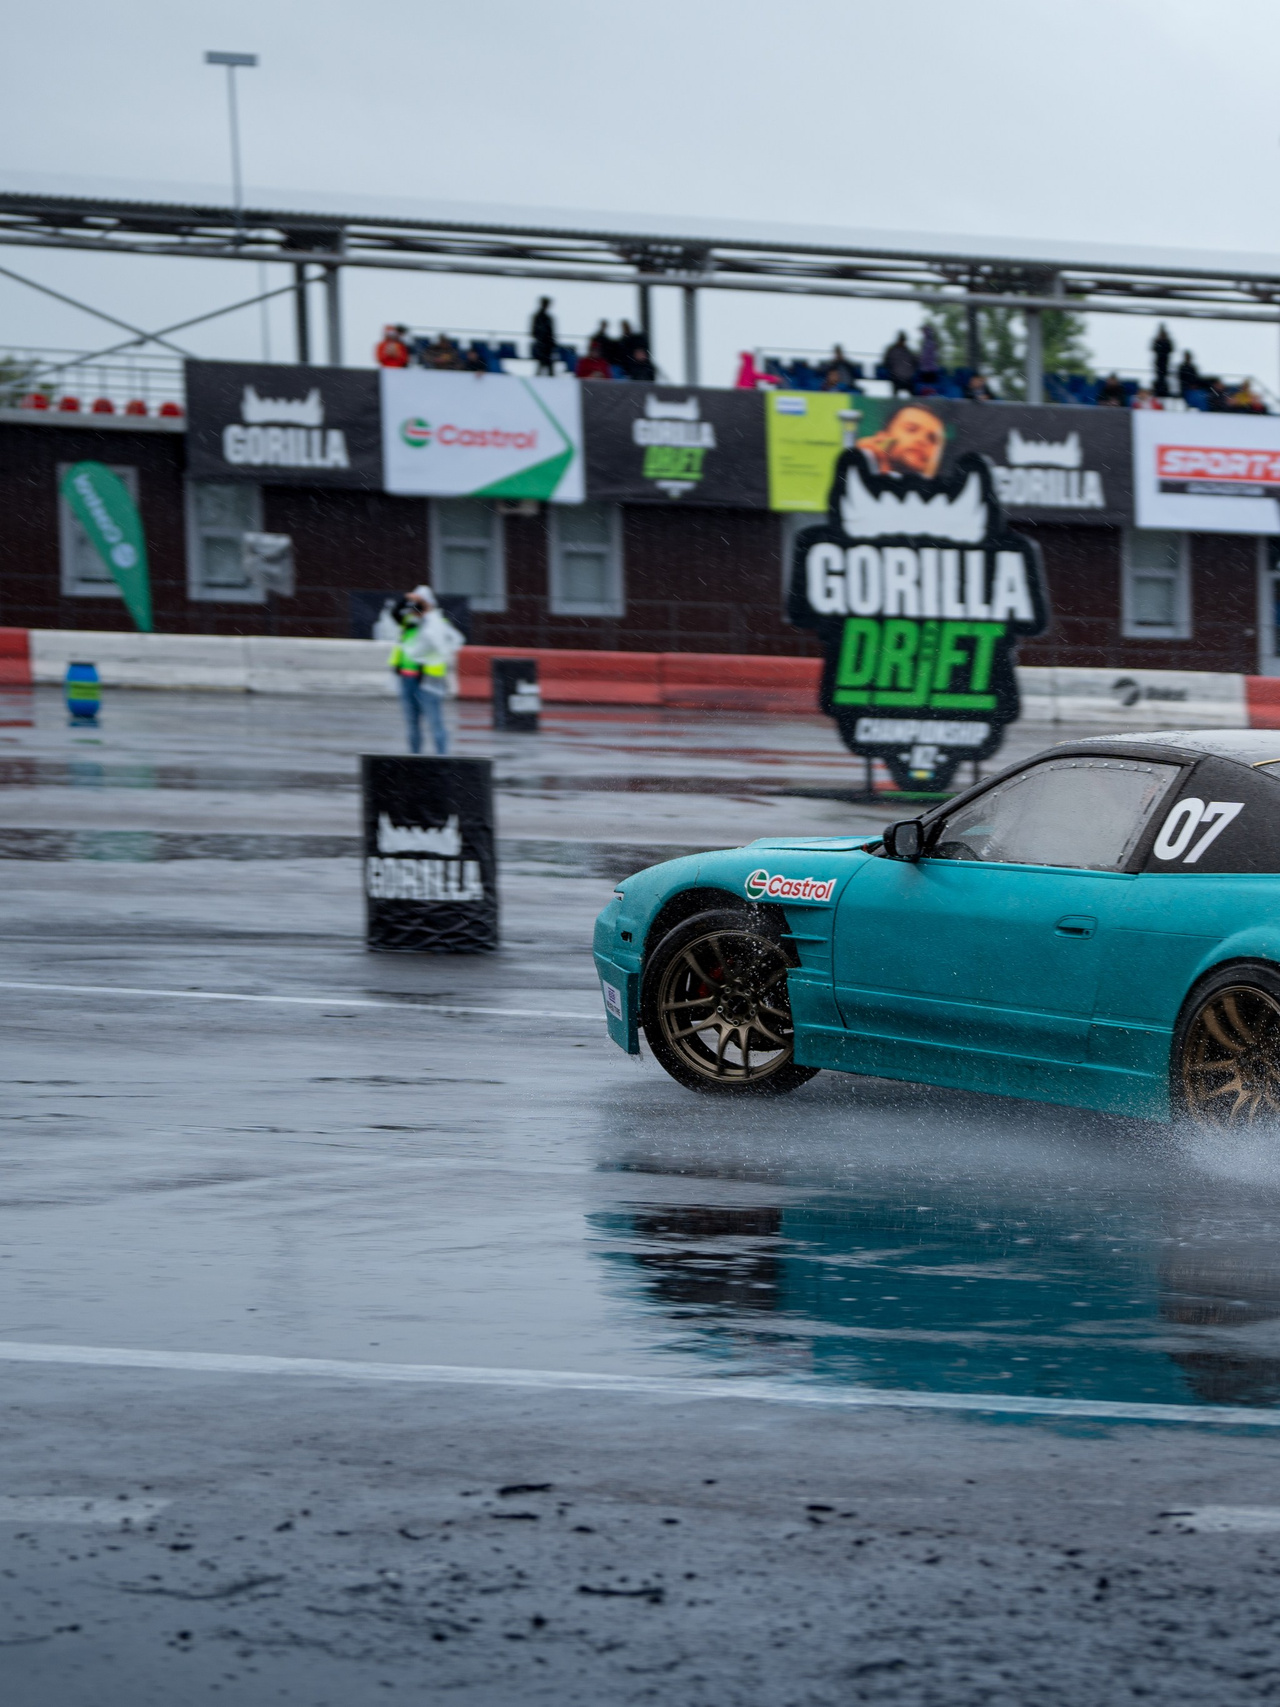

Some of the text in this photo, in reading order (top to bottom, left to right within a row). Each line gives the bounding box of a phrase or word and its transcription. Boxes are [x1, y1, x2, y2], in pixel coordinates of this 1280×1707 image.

[222, 424, 350, 468] GORILLA
[436, 424, 538, 450] Castrol
[991, 465, 1106, 509] GORILLA
[806, 541, 1035, 621] GORILLA
[834, 618, 1006, 709] DRIFT
[1153, 797, 1246, 864] 07
[366, 856, 484, 901] GORILLA
[768, 877, 834, 899] Castrol
